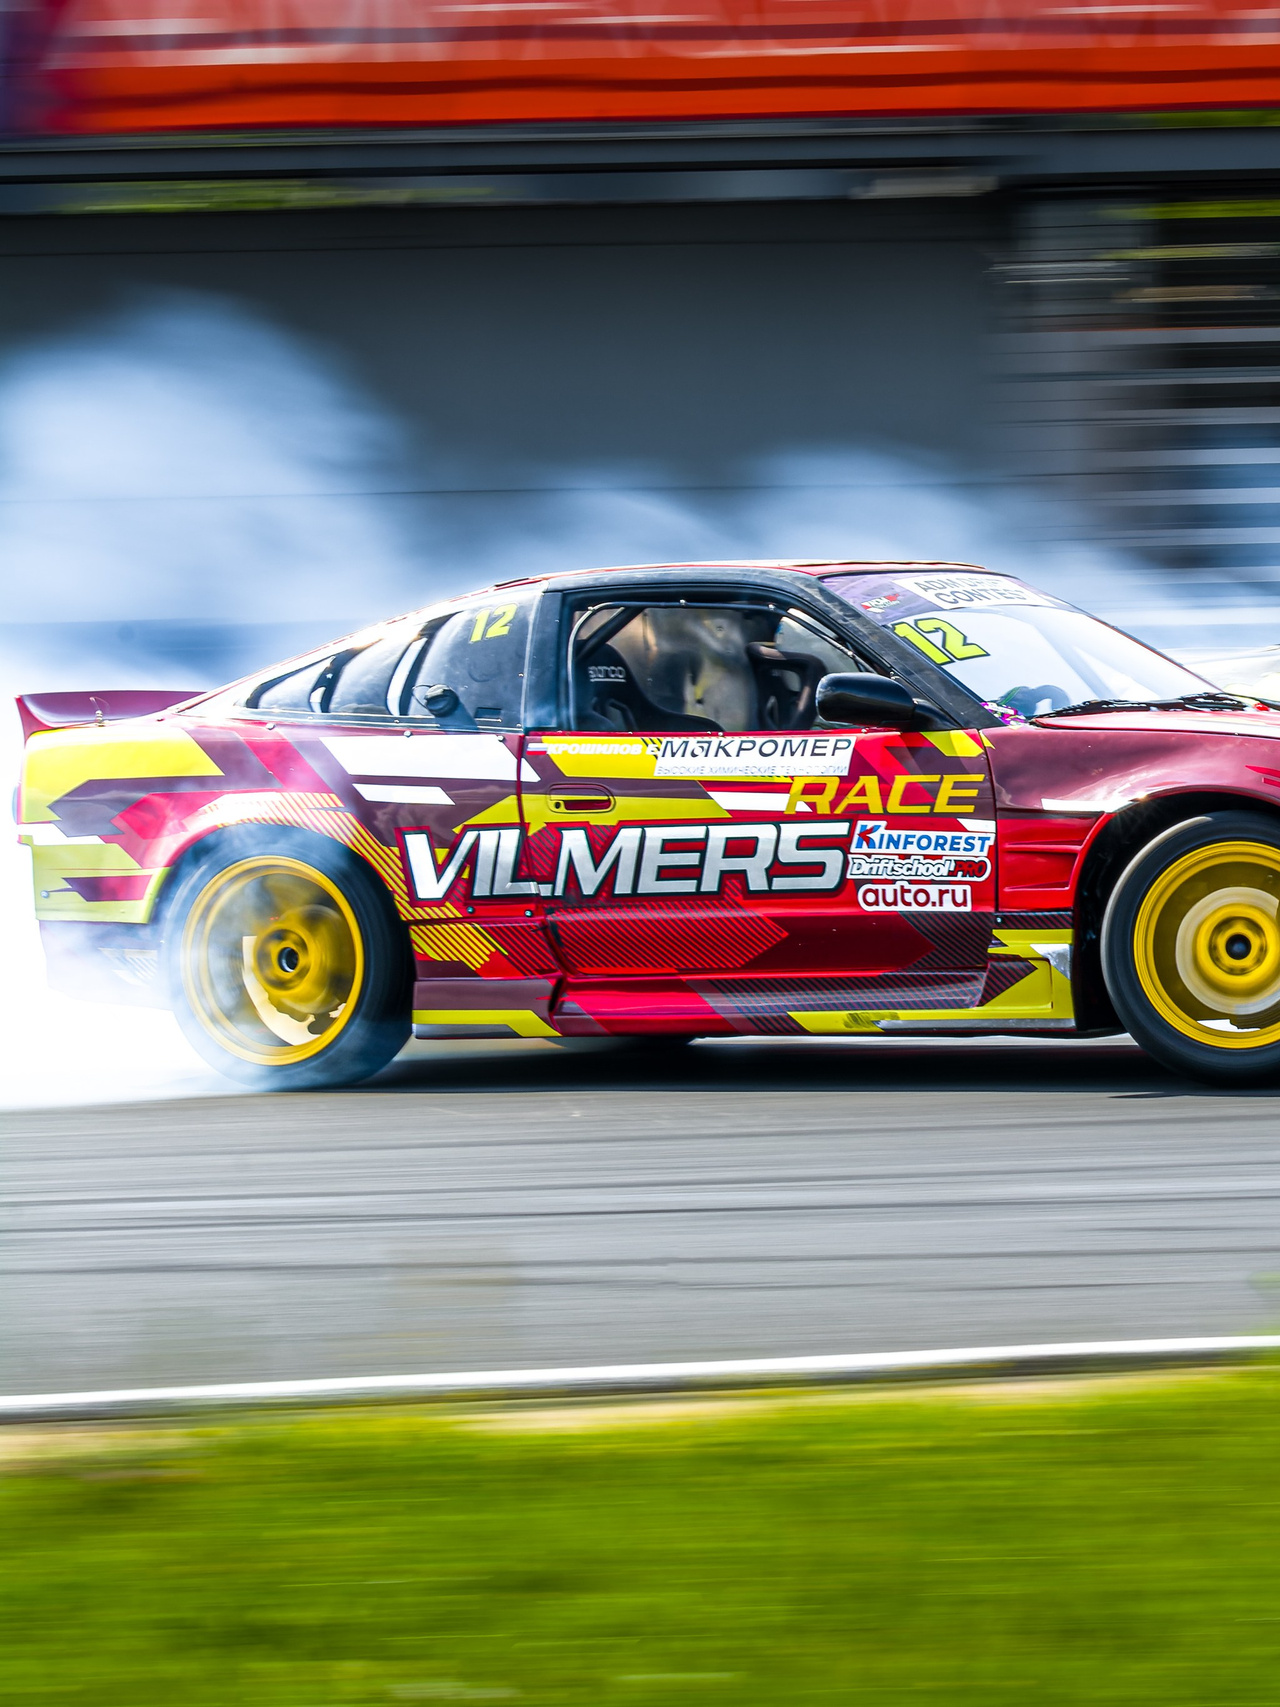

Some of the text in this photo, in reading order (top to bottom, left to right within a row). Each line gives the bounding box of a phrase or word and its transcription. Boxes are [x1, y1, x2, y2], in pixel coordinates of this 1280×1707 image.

[934, 588, 1030, 605] CONTES
[469, 603, 519, 643] 12
[891, 617, 990, 665] 12
[657, 766, 705, 775] ВЫСОКИЕ
[709, 765, 776, 775] ХИМИЧЕСКИЕ
[783, 775, 984, 815] RACE
[855, 824, 991, 853] KINFOREST
[404, 822, 851, 900] VILMERS
[862, 885, 968, 908] auto.ru
